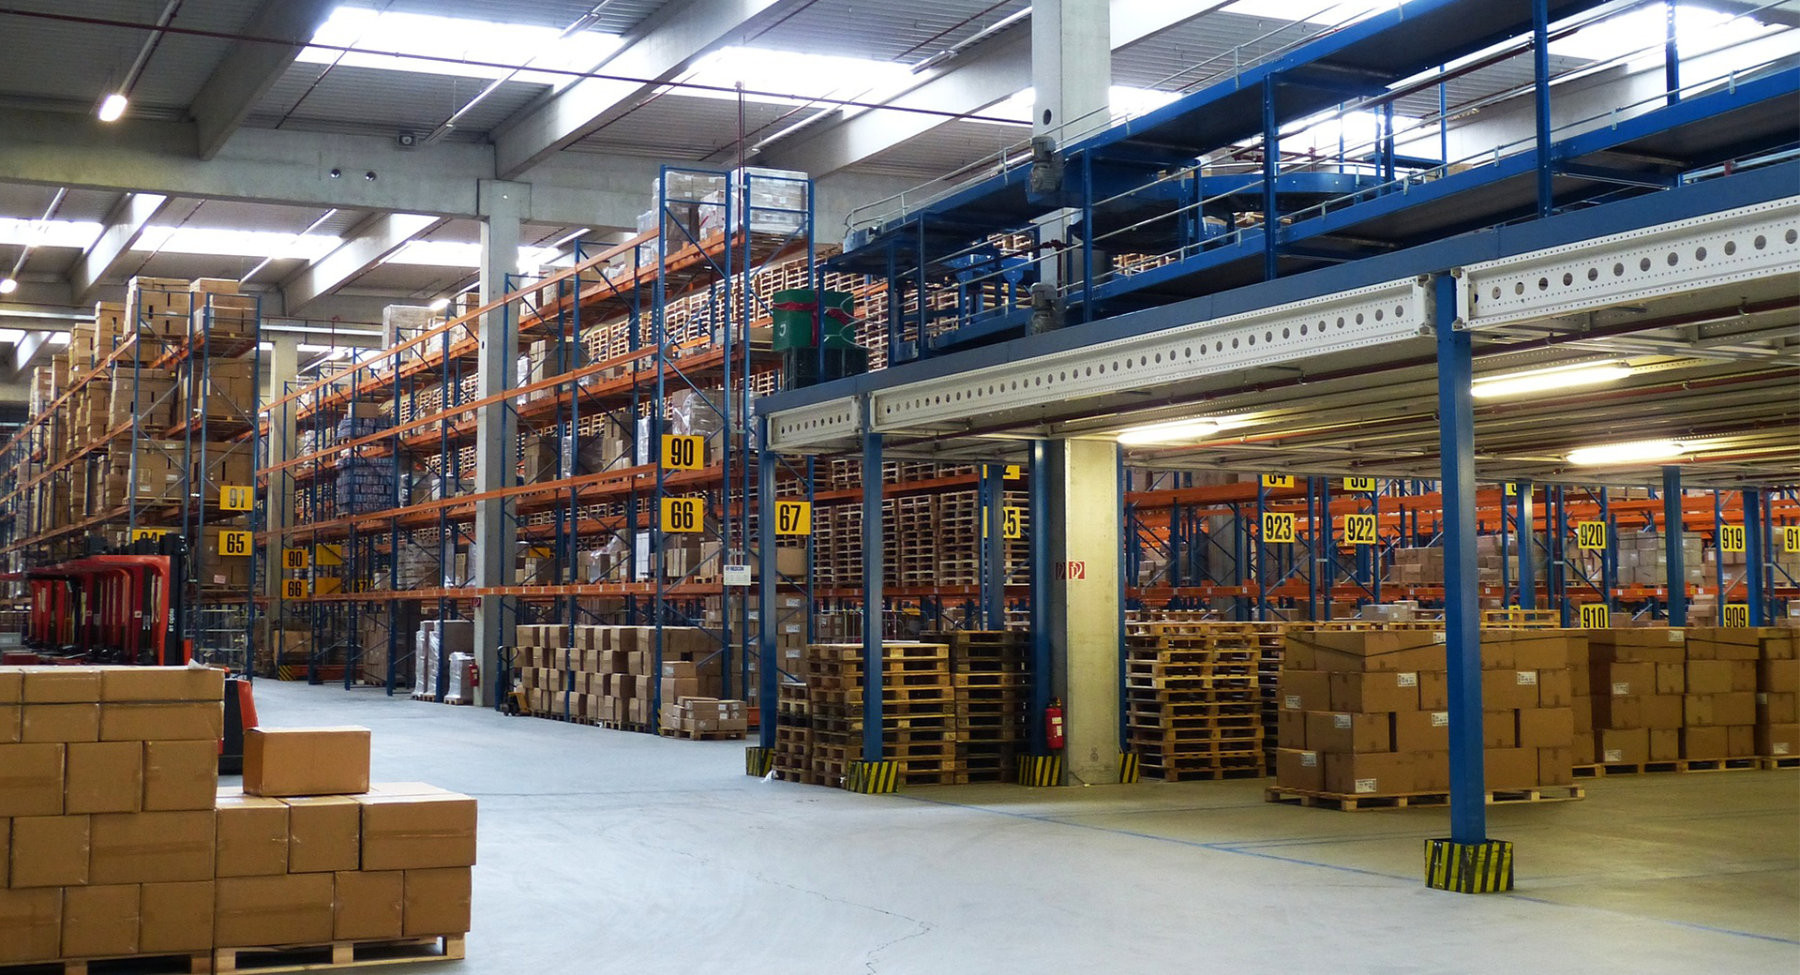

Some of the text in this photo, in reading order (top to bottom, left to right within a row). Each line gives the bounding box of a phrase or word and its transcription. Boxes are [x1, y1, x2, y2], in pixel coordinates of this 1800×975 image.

[670, 438, 694, 466] 90
[228, 488, 245, 508] 91
[670, 501, 694, 529] 66
[779, 504, 801, 531] 67
[1265, 515, 1292, 540] 923
[1347, 516, 1373, 541] 922
[1580, 524, 1603, 547] 920
[1722, 527, 1743, 549] 919
[226, 533, 245, 553] 65
[1787, 528, 1800, 550] 91
[288, 551, 303, 567] 90
[287, 581, 302, 597] 66
[1582, 607, 1605, 629] 910
[1725, 606, 1746, 628] 909
